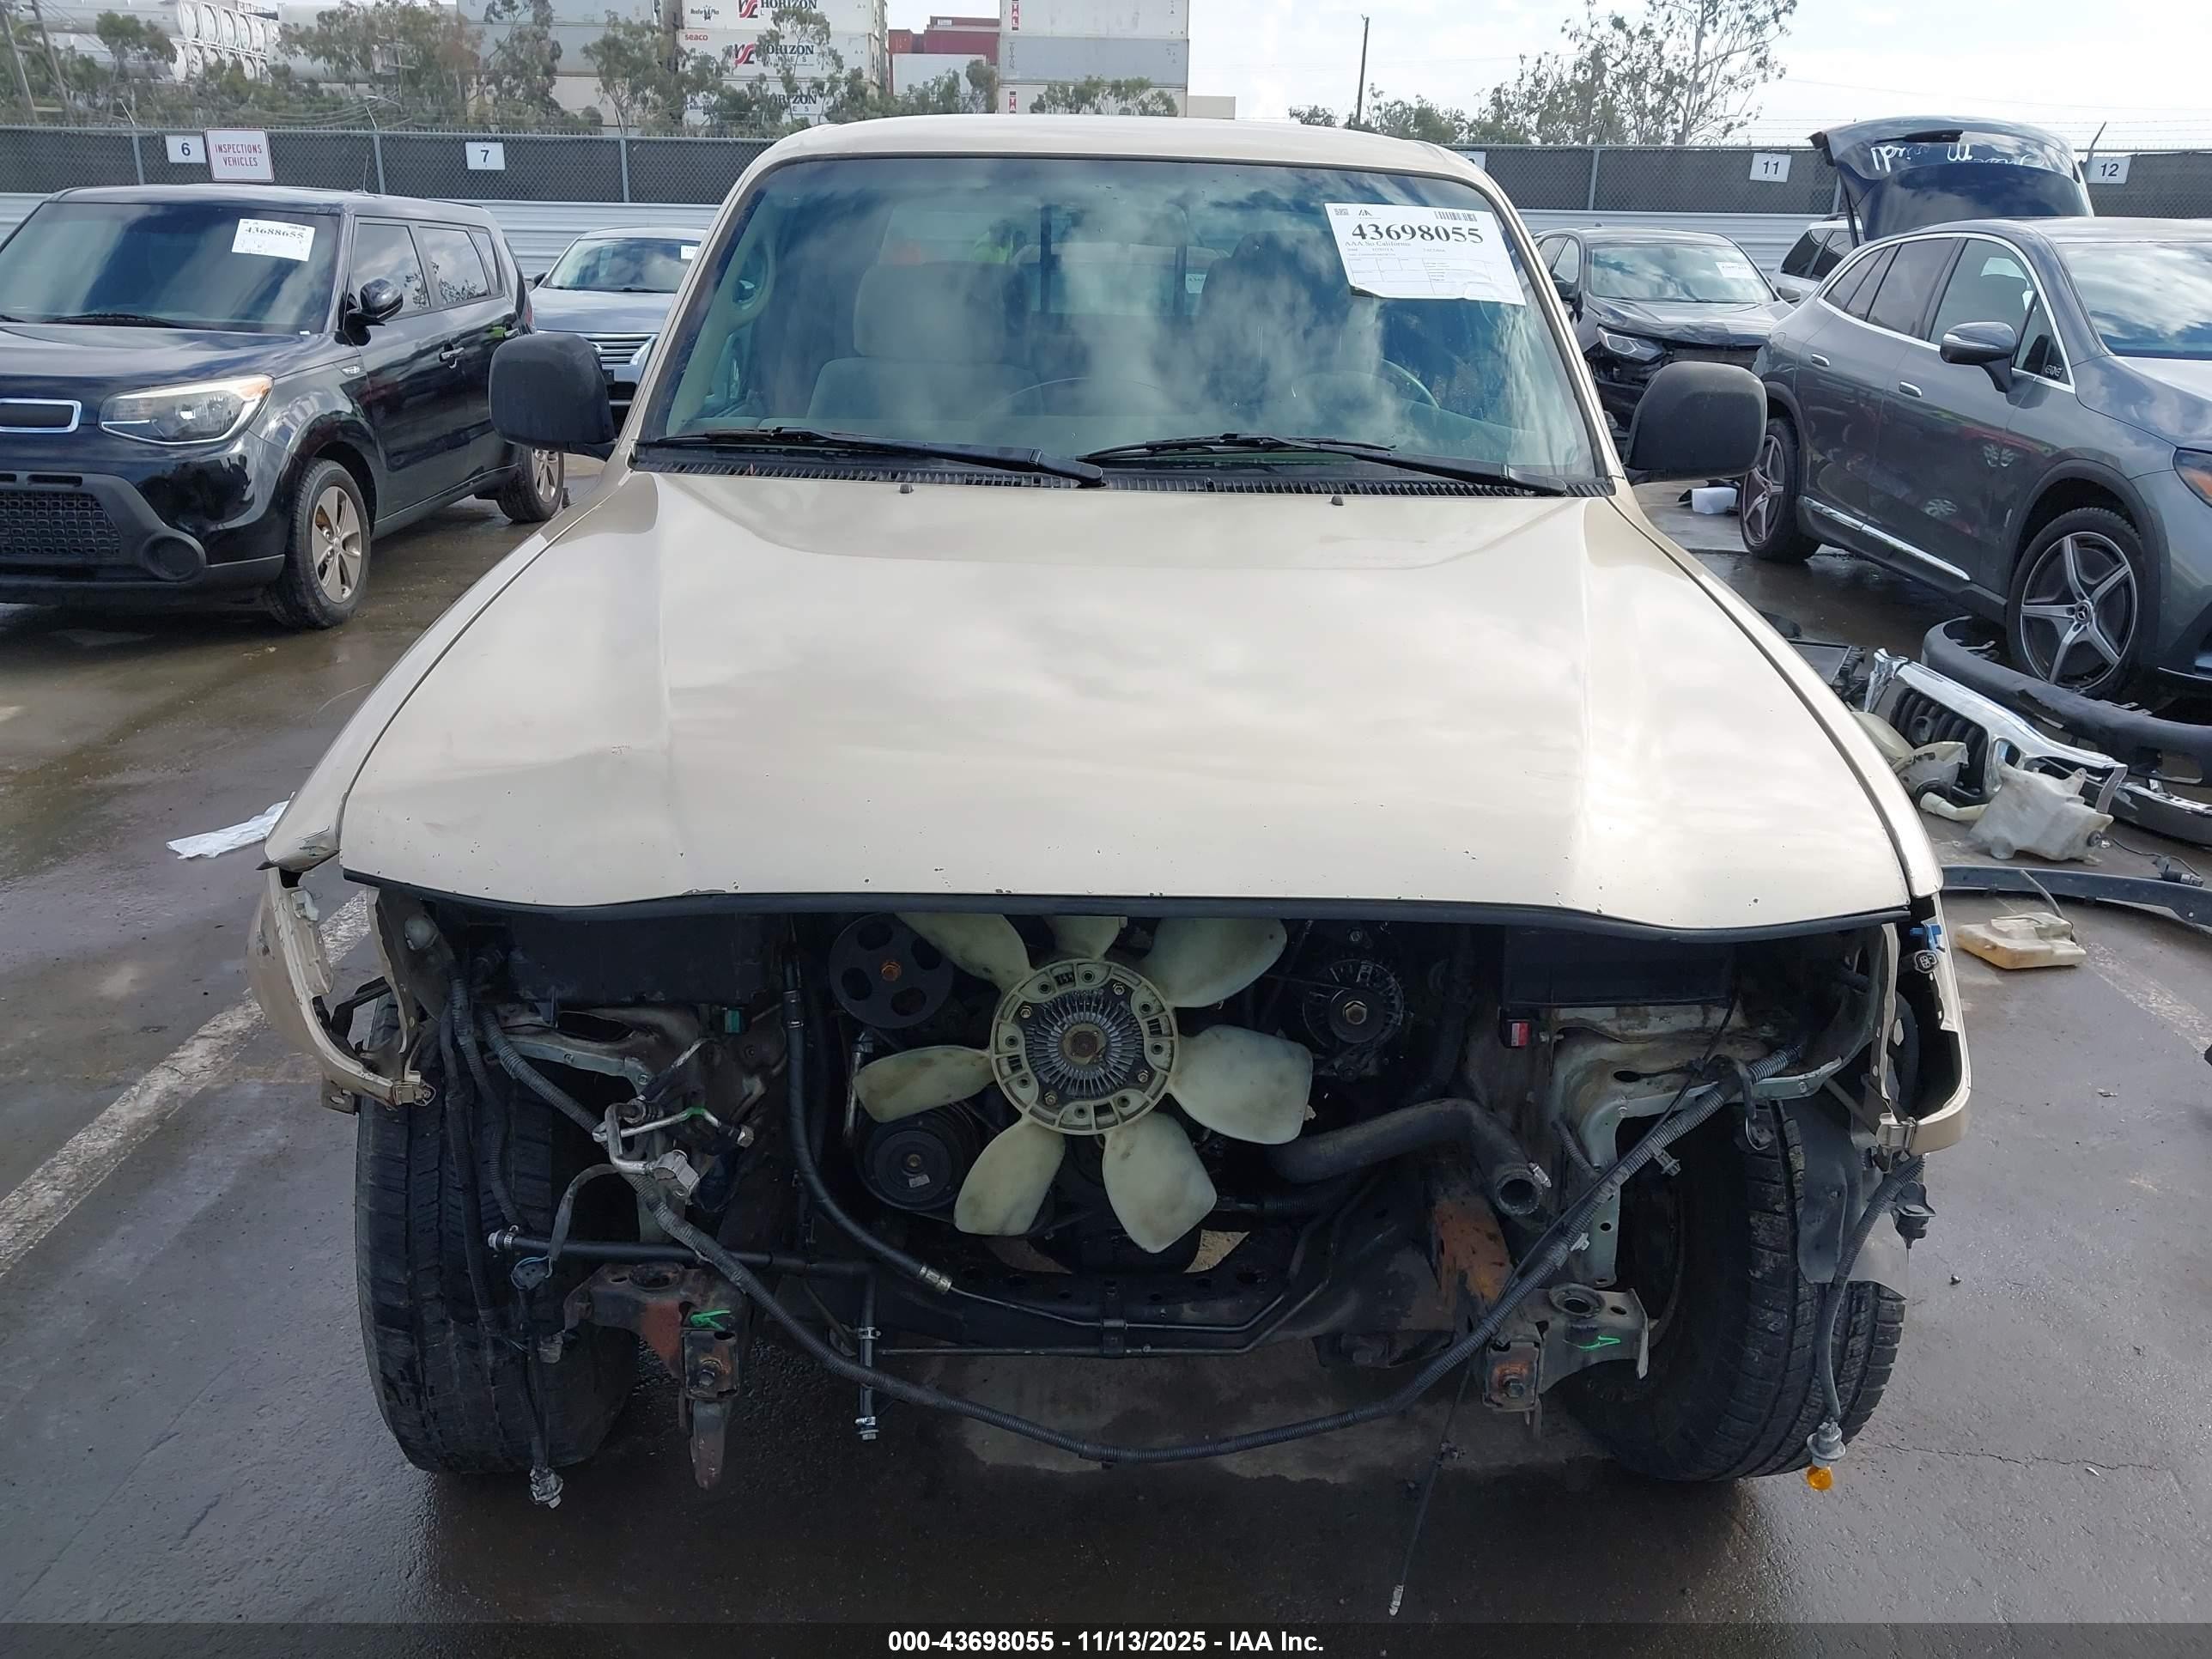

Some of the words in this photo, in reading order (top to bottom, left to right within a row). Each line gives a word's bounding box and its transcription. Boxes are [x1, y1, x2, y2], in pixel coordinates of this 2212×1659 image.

[766, 45, 814, 54] ORIZON
[180, 143, 191, 156] 6
[215, 143, 262, 154] INSPECTIONS
[222, 156, 258, 167] VEHICLES
[481, 149, 489, 163] 7
[1763, 161, 1779, 175] 11
[2100, 163, 2119, 177] 12
[1352, 223, 1484, 244] 43698055
